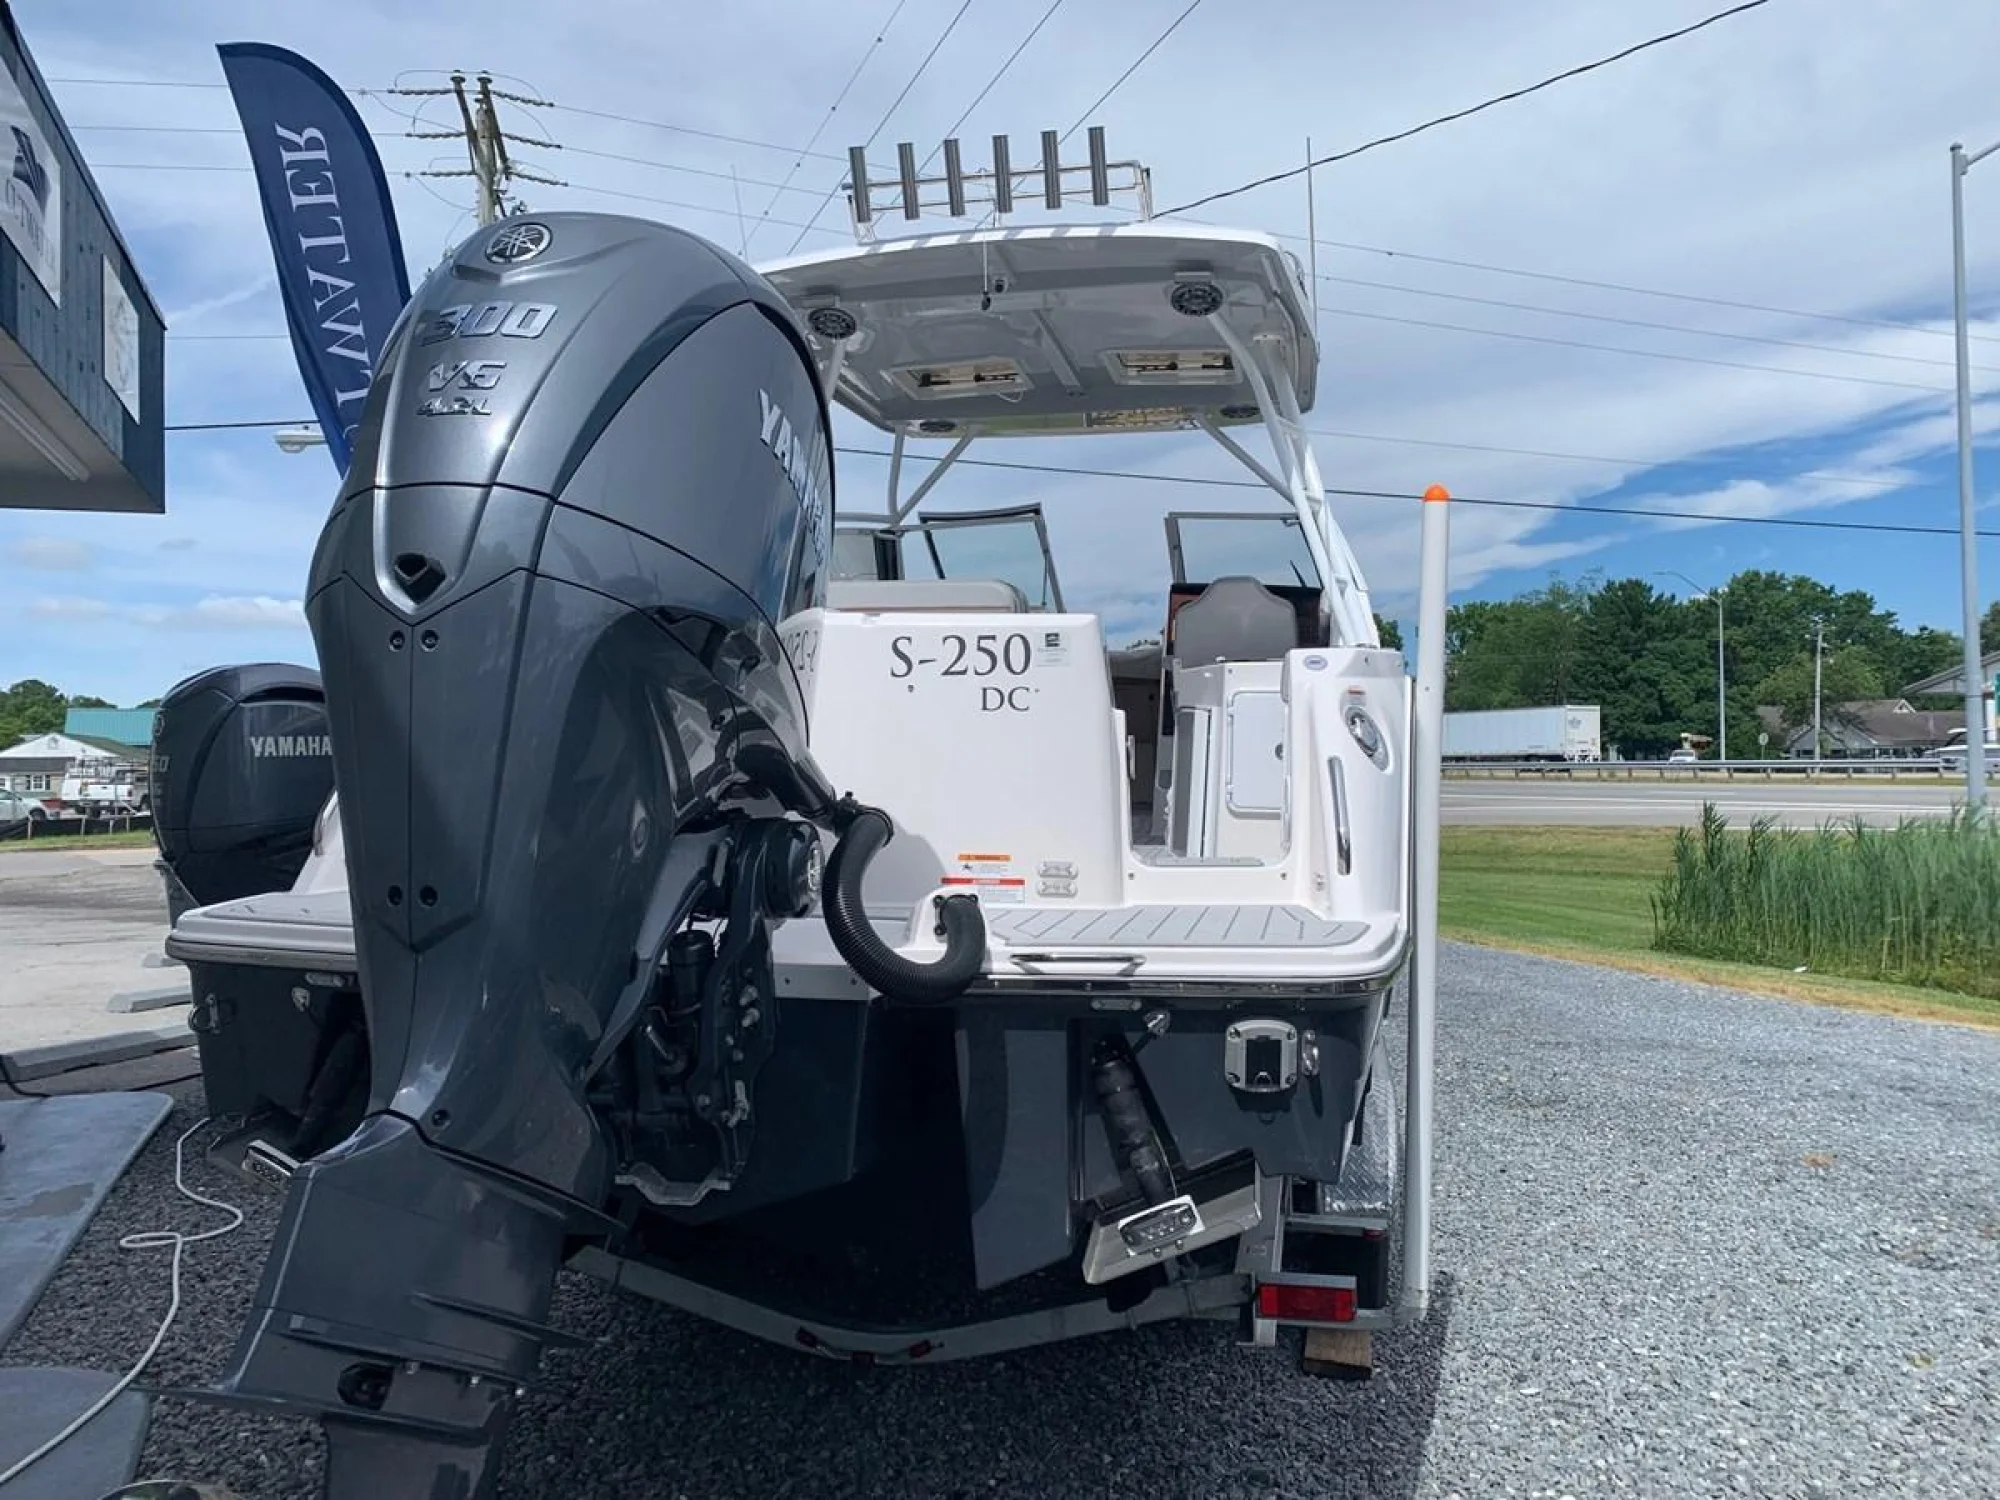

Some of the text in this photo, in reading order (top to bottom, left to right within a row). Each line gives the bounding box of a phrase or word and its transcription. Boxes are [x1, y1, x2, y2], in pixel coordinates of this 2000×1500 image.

[416, 301, 558, 346] 300
[428, 359, 508, 392] V6
[890, 632, 1032, 678] S-250
[981, 686, 1031, 712] DC
[250, 735, 333, 758] YAMAHA
